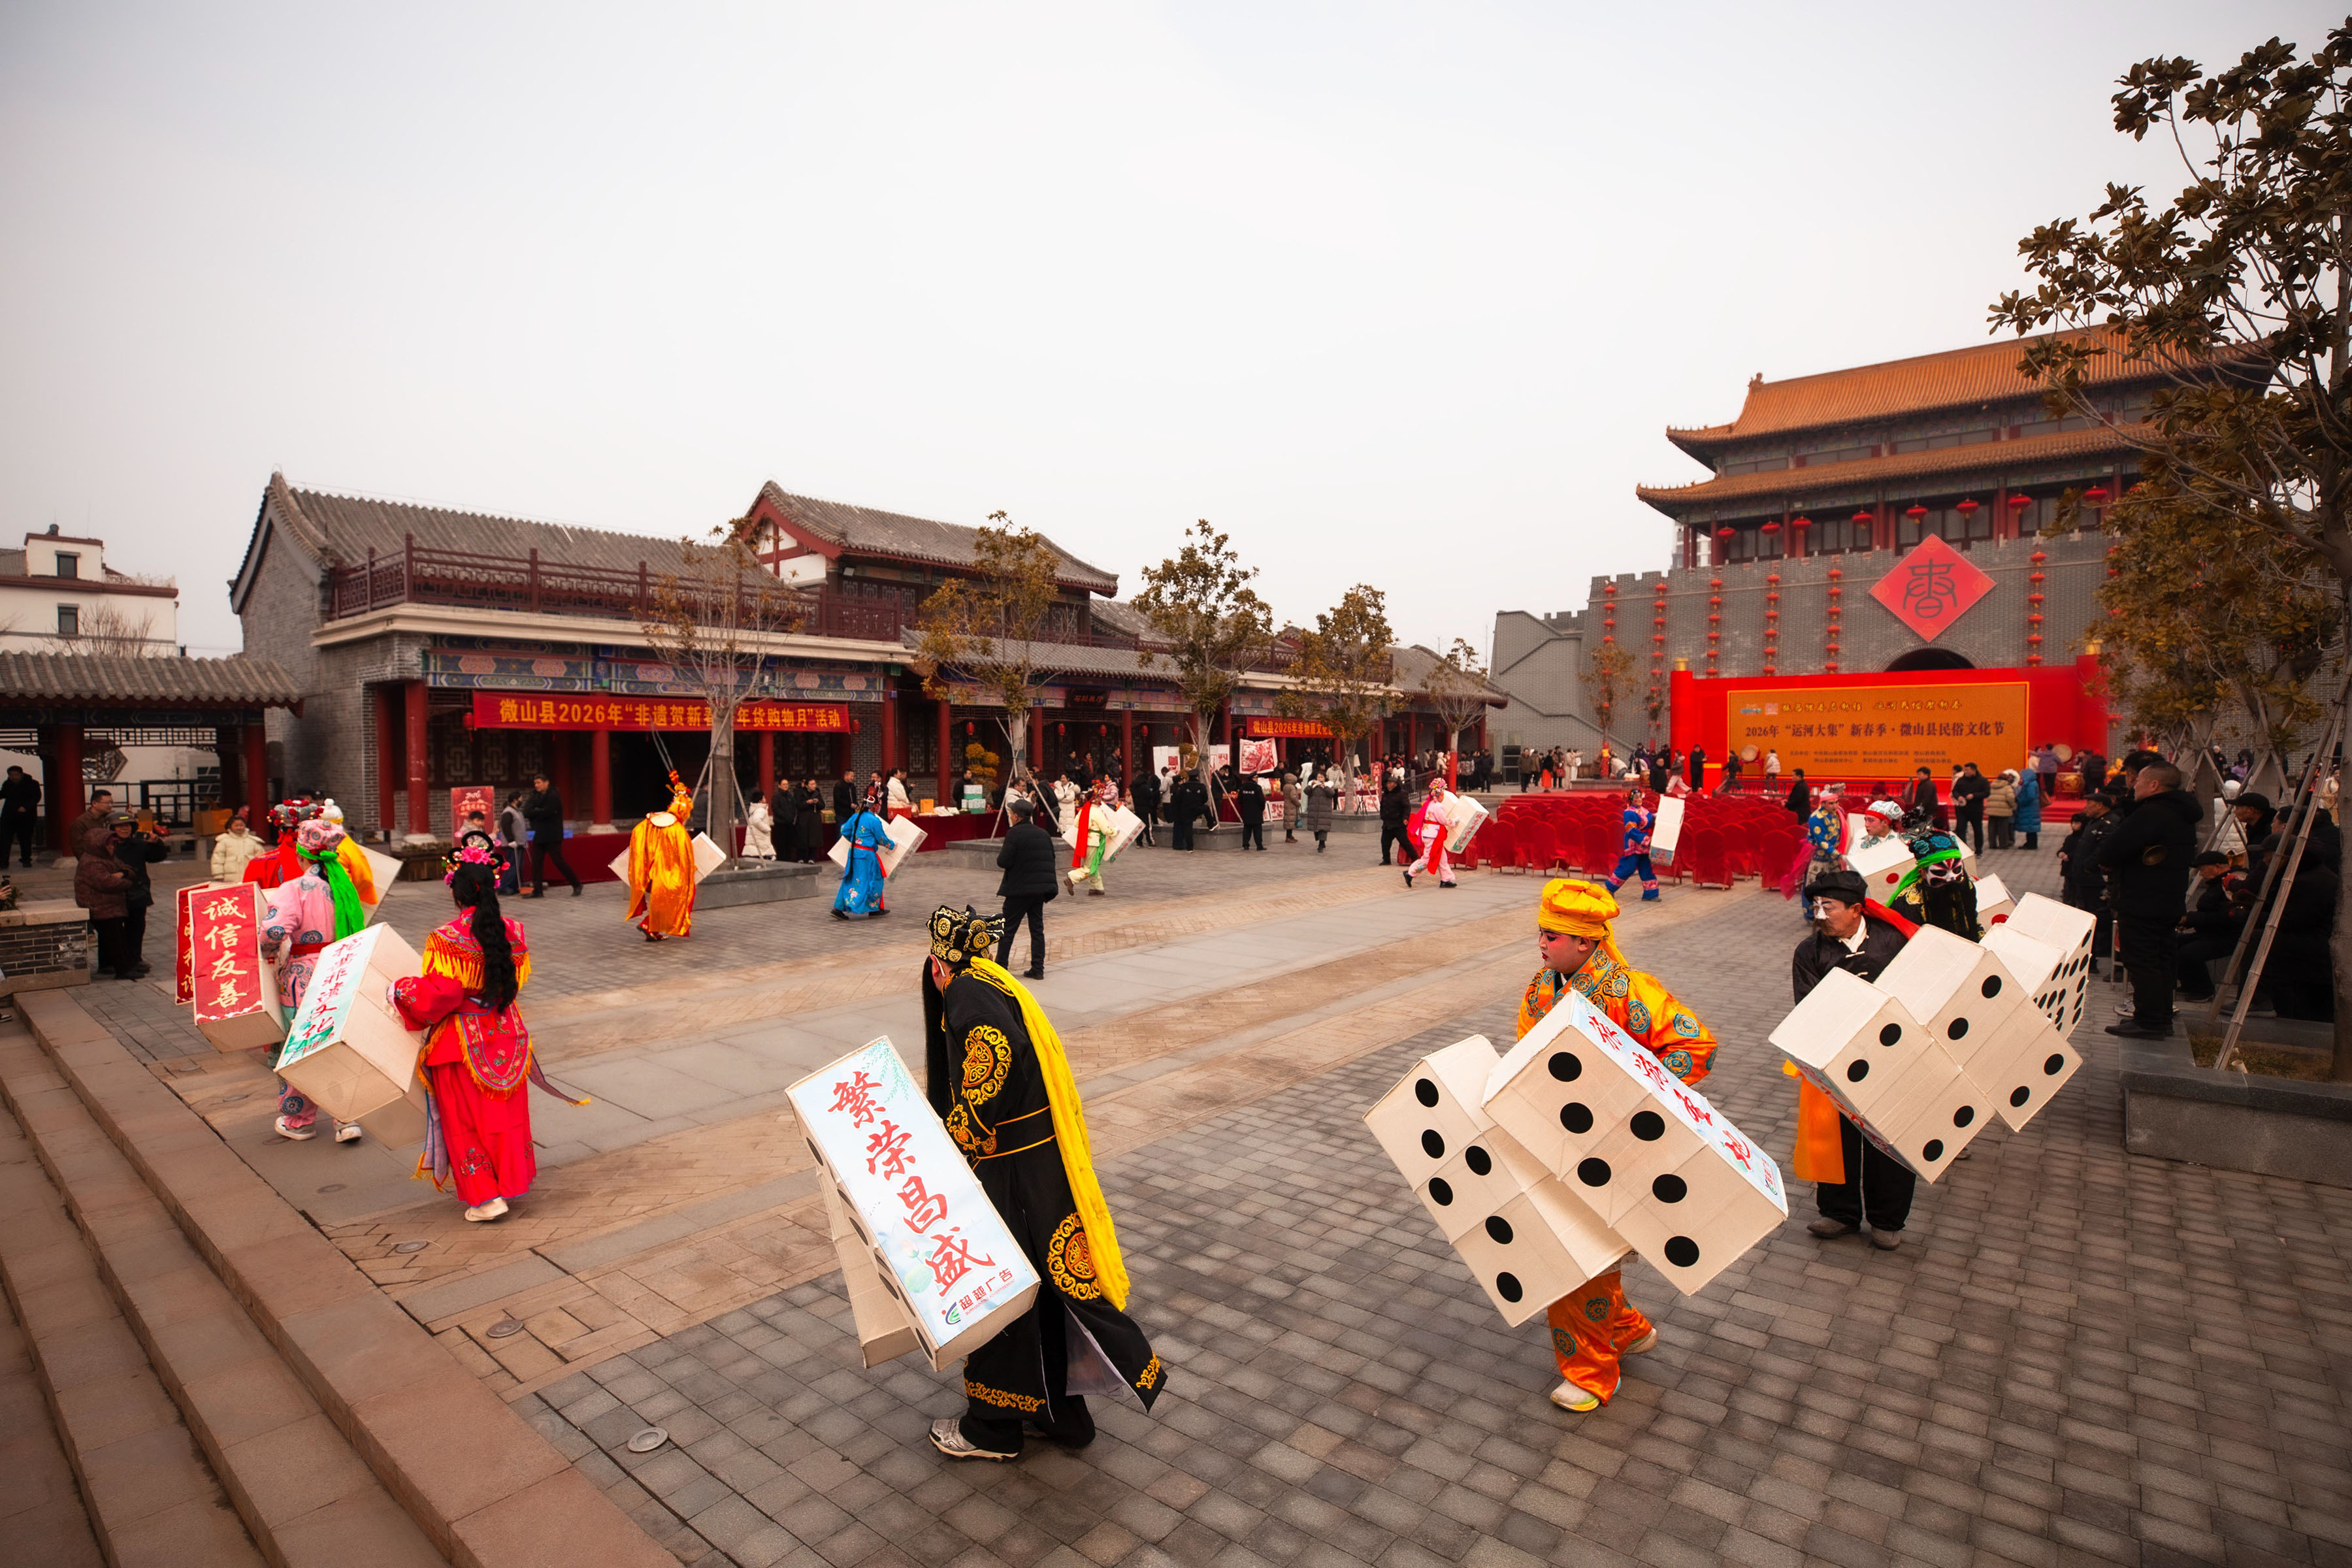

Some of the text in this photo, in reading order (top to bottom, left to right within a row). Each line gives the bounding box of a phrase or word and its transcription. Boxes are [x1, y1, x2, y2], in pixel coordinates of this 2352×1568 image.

[827, 1070, 996, 1297] 繁荣昌盛
[958, 1267, 1013, 1311] 超越广告
